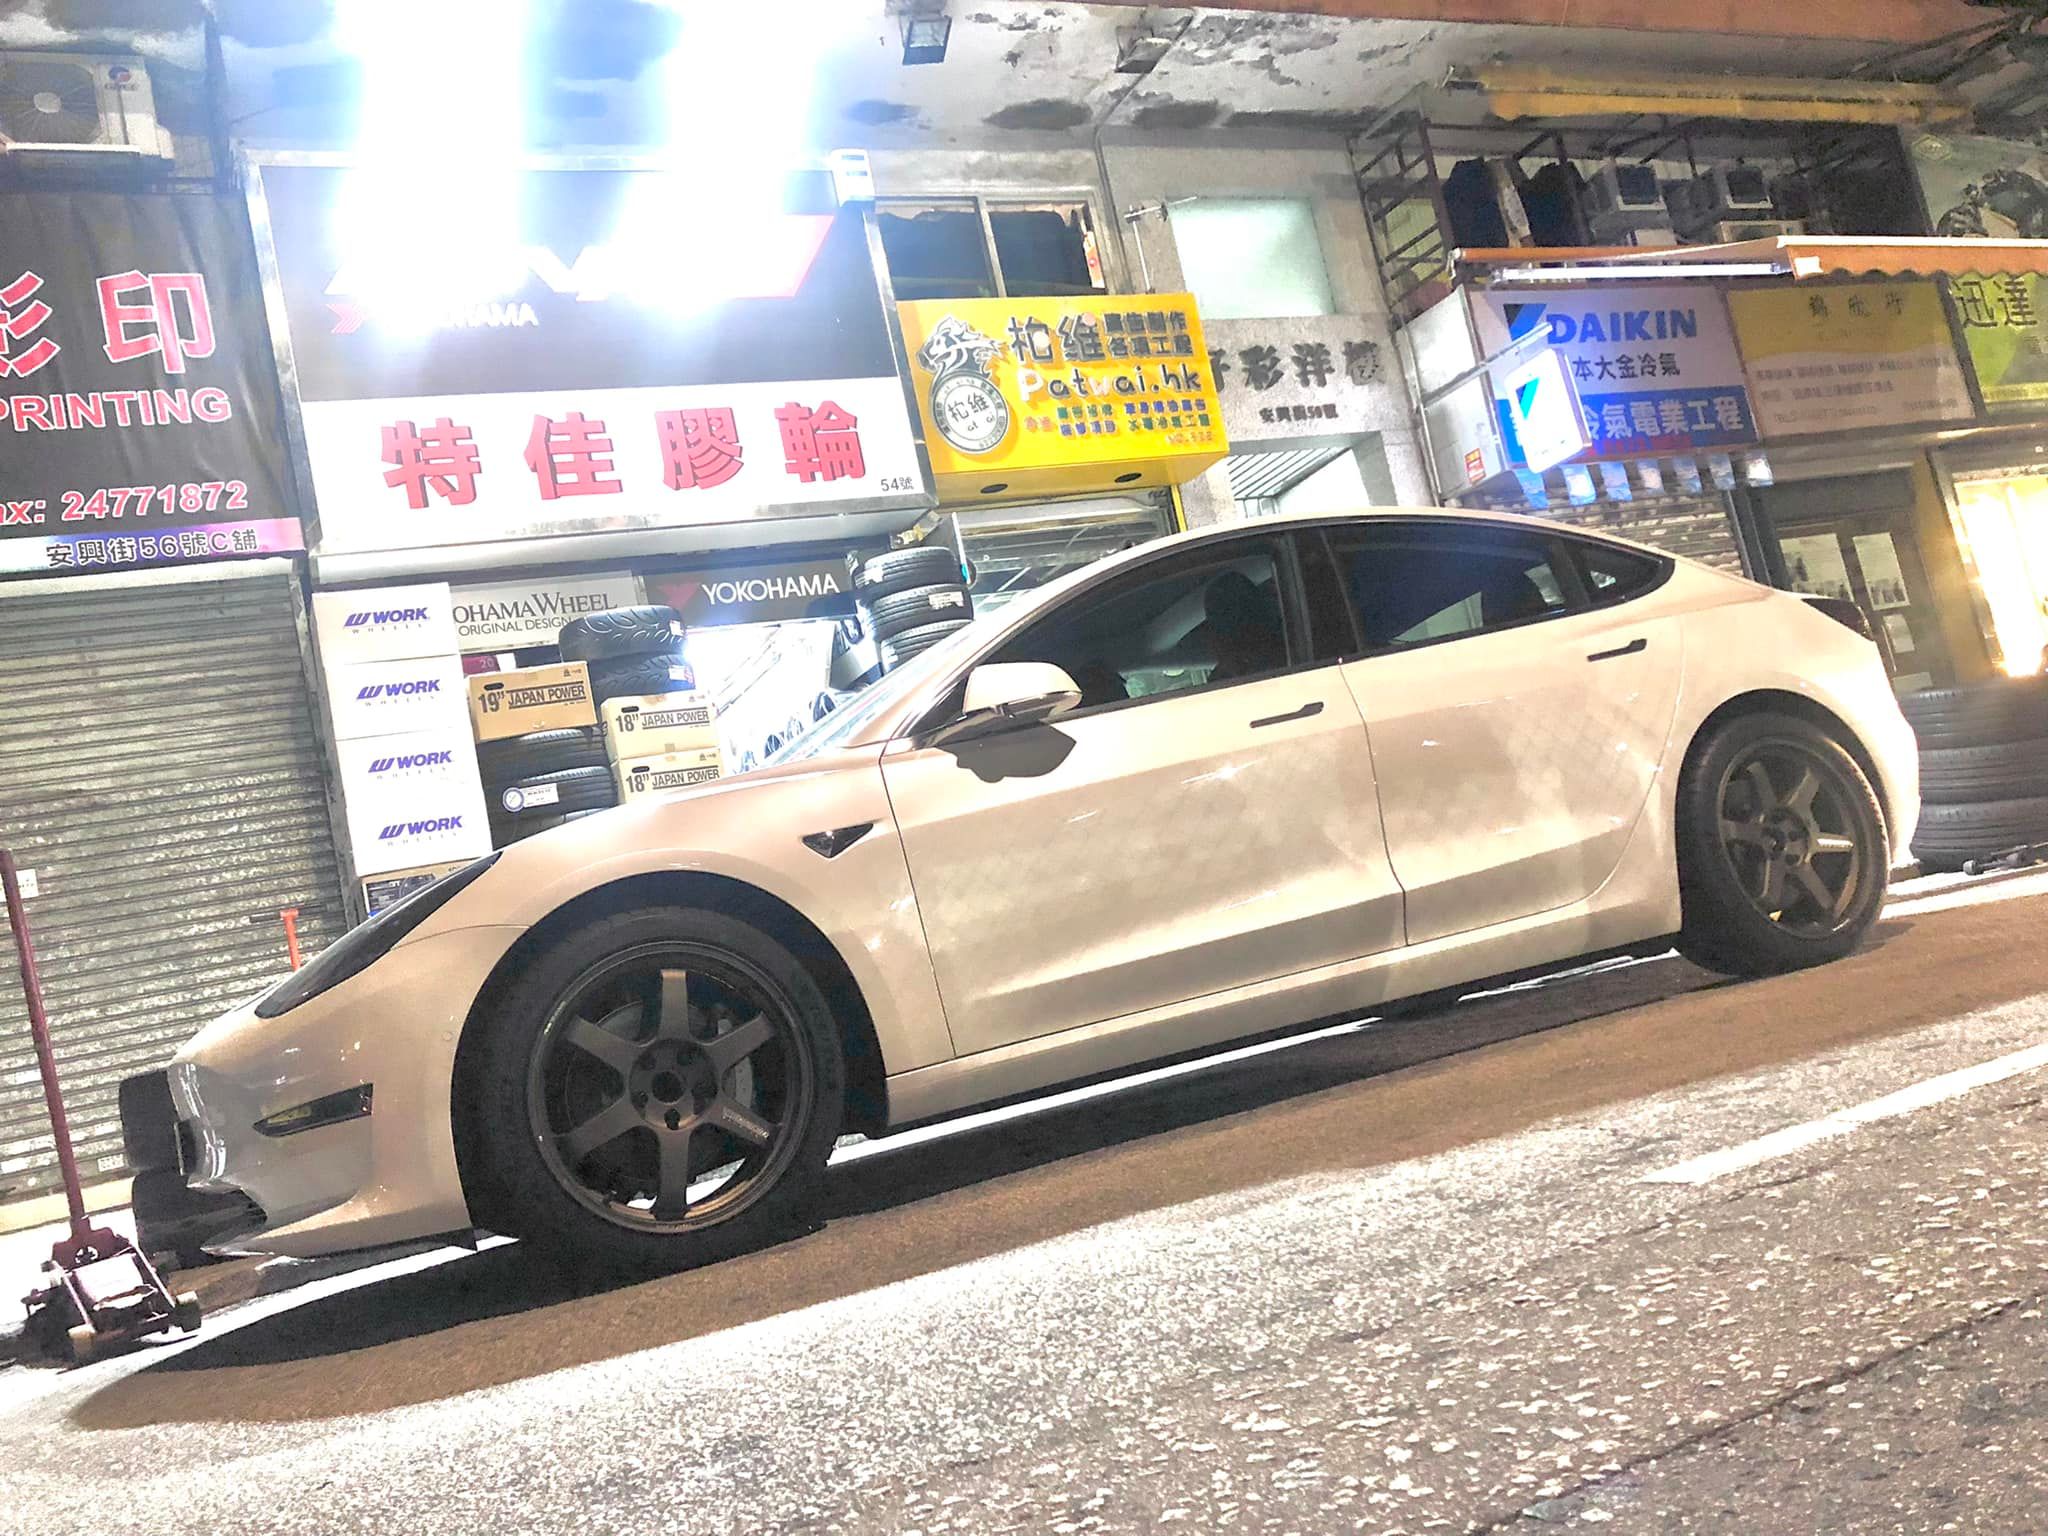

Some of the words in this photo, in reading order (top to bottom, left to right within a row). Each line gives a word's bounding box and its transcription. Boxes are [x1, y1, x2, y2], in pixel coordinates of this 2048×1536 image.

[1546, 309, 1698, 344] DAIKIN
[0, 387, 232, 432] RINTING
[380, 400, 867, 510] 特佳膠輪
[61, 480, 248, 521] 24771872
[702, 573, 840, 605] YOKOHAMA
[372, 607, 429, 625] WORK
[458, 623, 523, 637] ORIGINAL
[385, 679, 441, 697] WORK
[508, 691, 545, 706] JAPAN
[547, 685, 586, 700] POWER
[641, 714, 674, 727] JAPAN
[676, 710, 710, 722] POWER
[396, 750, 453, 770] WORK
[651, 774, 685, 788] JAPAN
[687, 768, 721, 782] POWER
[406, 815, 463, 836] WORK
